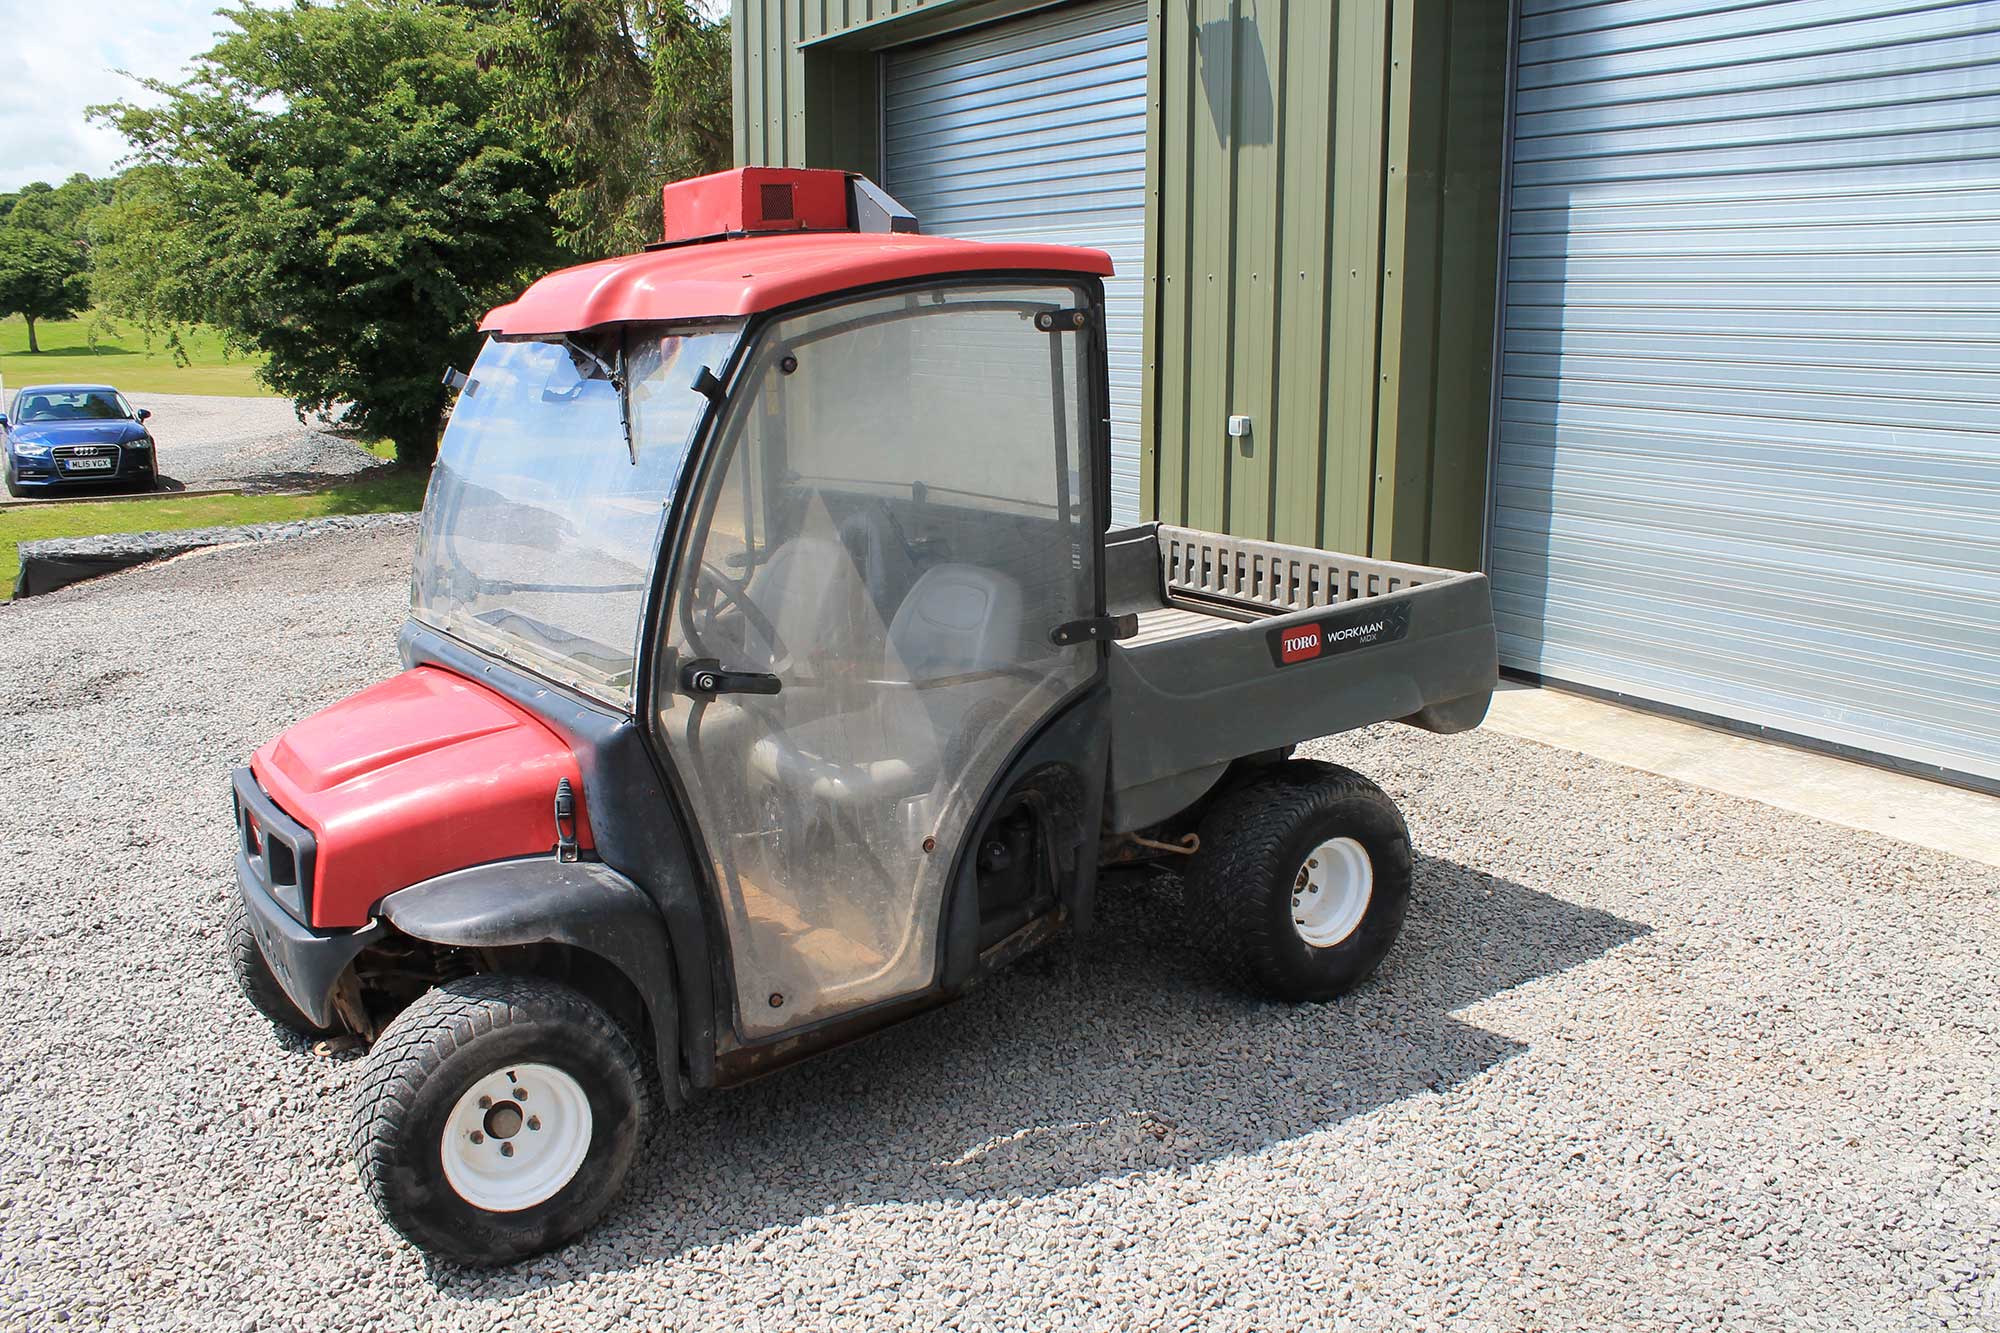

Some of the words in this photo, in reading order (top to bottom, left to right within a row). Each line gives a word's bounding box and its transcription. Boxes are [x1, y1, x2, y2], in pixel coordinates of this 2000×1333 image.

[1327, 621, 1384, 643] WORKMAN
[1359, 633, 1377, 644] MDX
[1284, 634, 1318, 653] TORO
